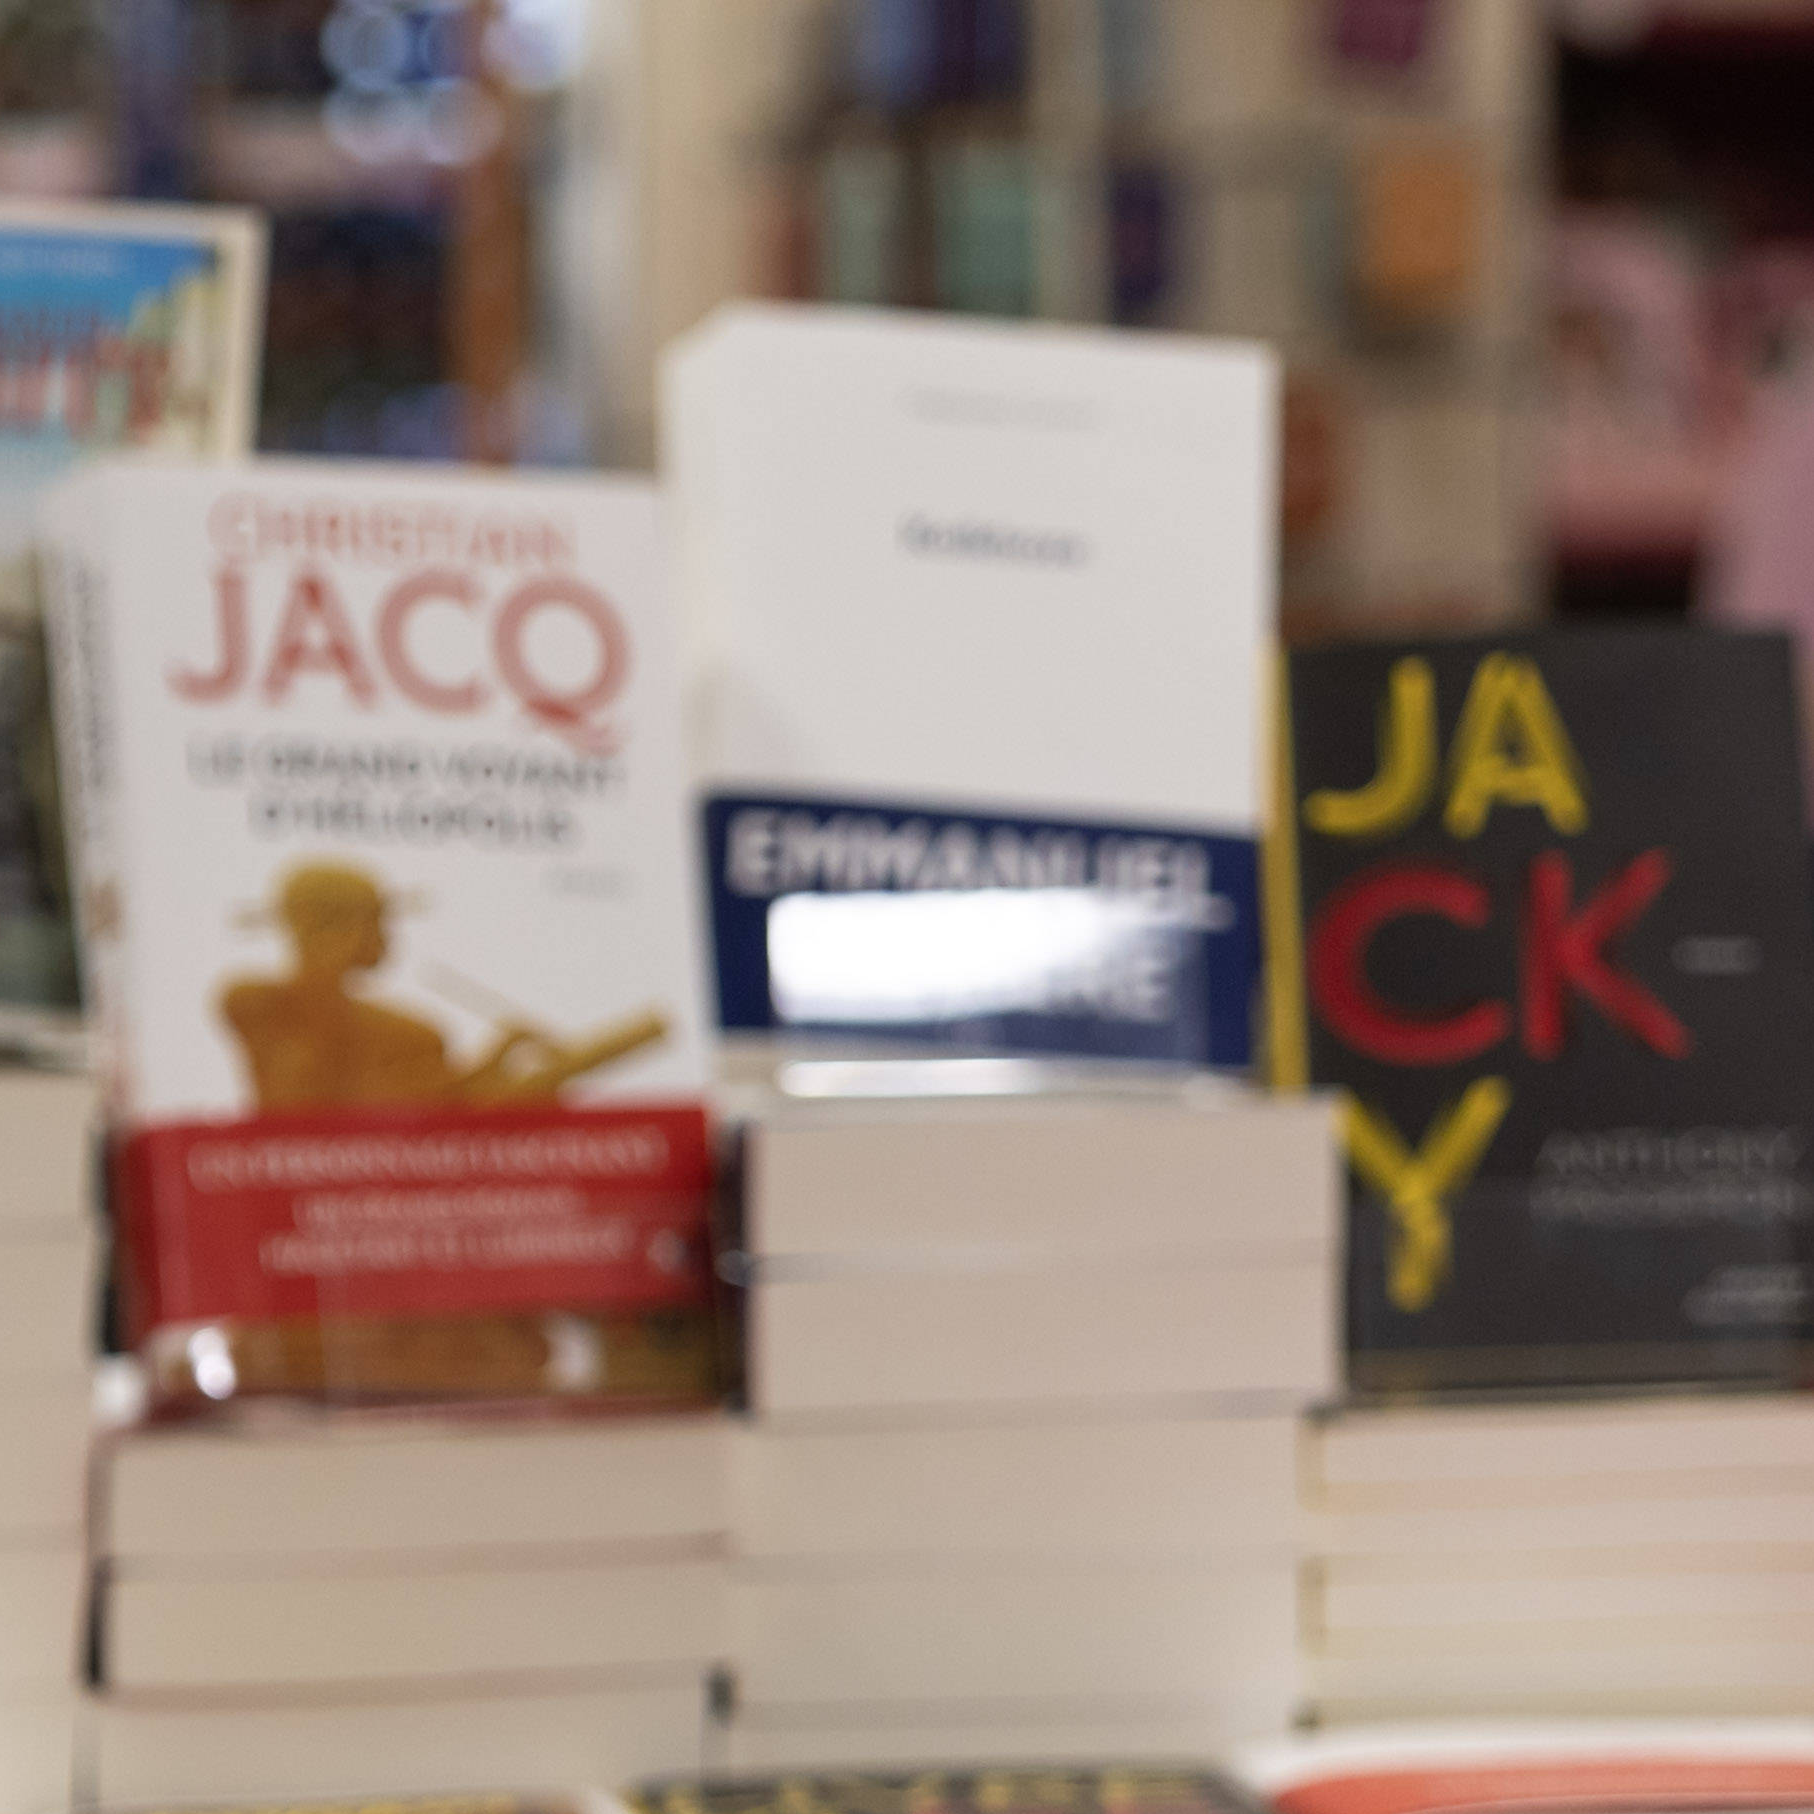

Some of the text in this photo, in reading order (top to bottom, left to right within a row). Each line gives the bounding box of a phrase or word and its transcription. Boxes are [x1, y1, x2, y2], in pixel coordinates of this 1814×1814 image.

[169, 569, 633, 754] JACQ
[1301, 648, 1588, 838] JA
[1310, 848, 1695, 1065] CK
[1340, 1075, 1514, 1312] Y
